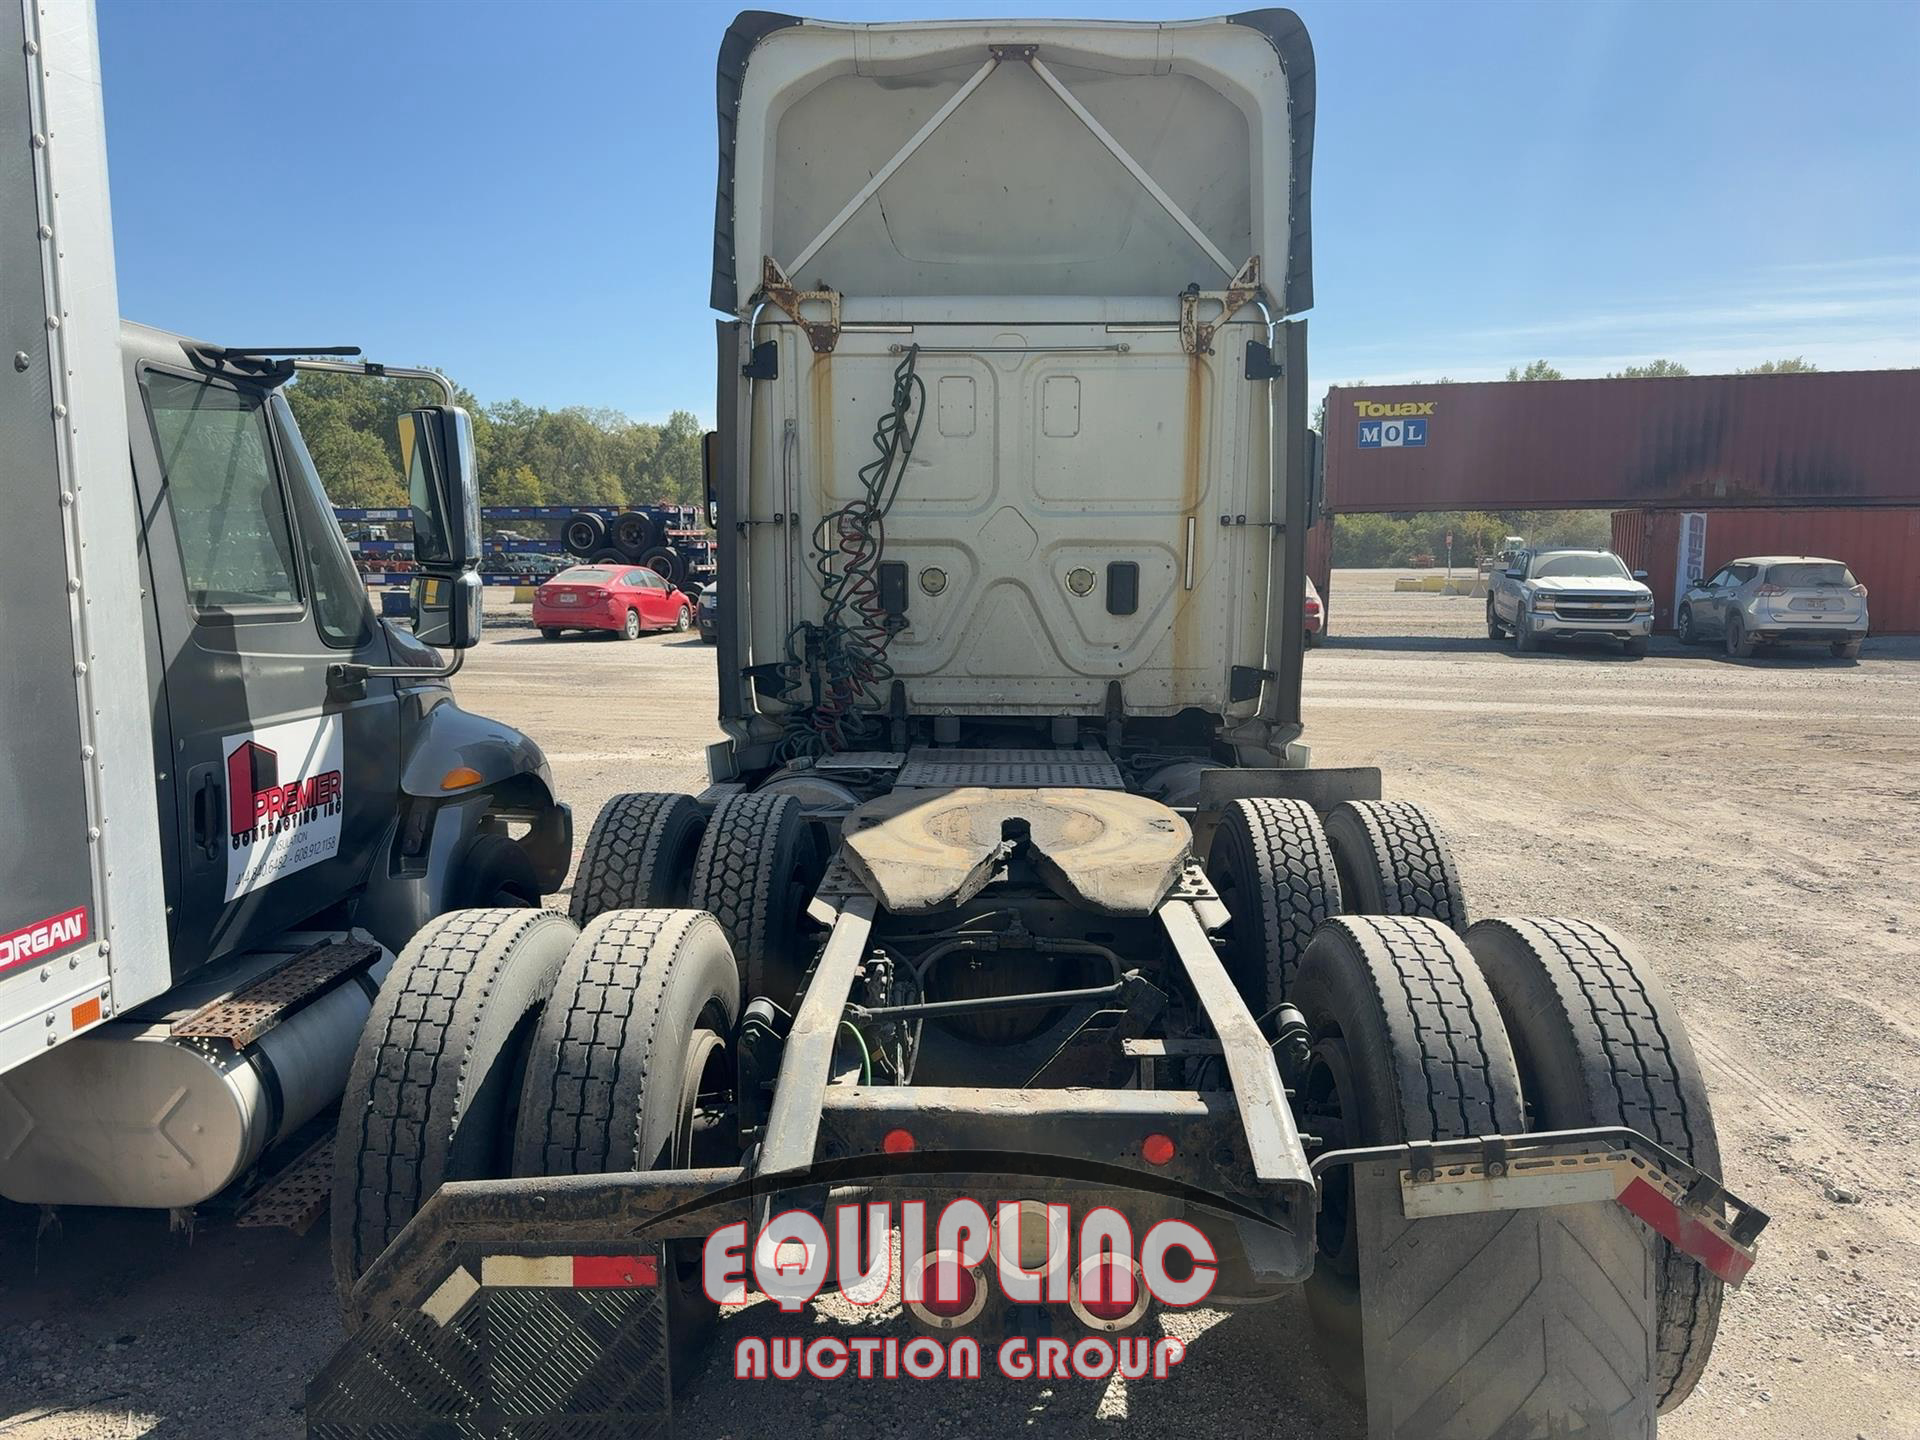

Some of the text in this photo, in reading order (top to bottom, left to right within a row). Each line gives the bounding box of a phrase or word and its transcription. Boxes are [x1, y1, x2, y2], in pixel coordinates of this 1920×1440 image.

[1353, 401, 1434, 417] Touax
[1360, 425, 1422, 443] MOL
[253, 770, 342, 824] PREMIER
[232, 801, 342, 850] CONTRACTING INC
